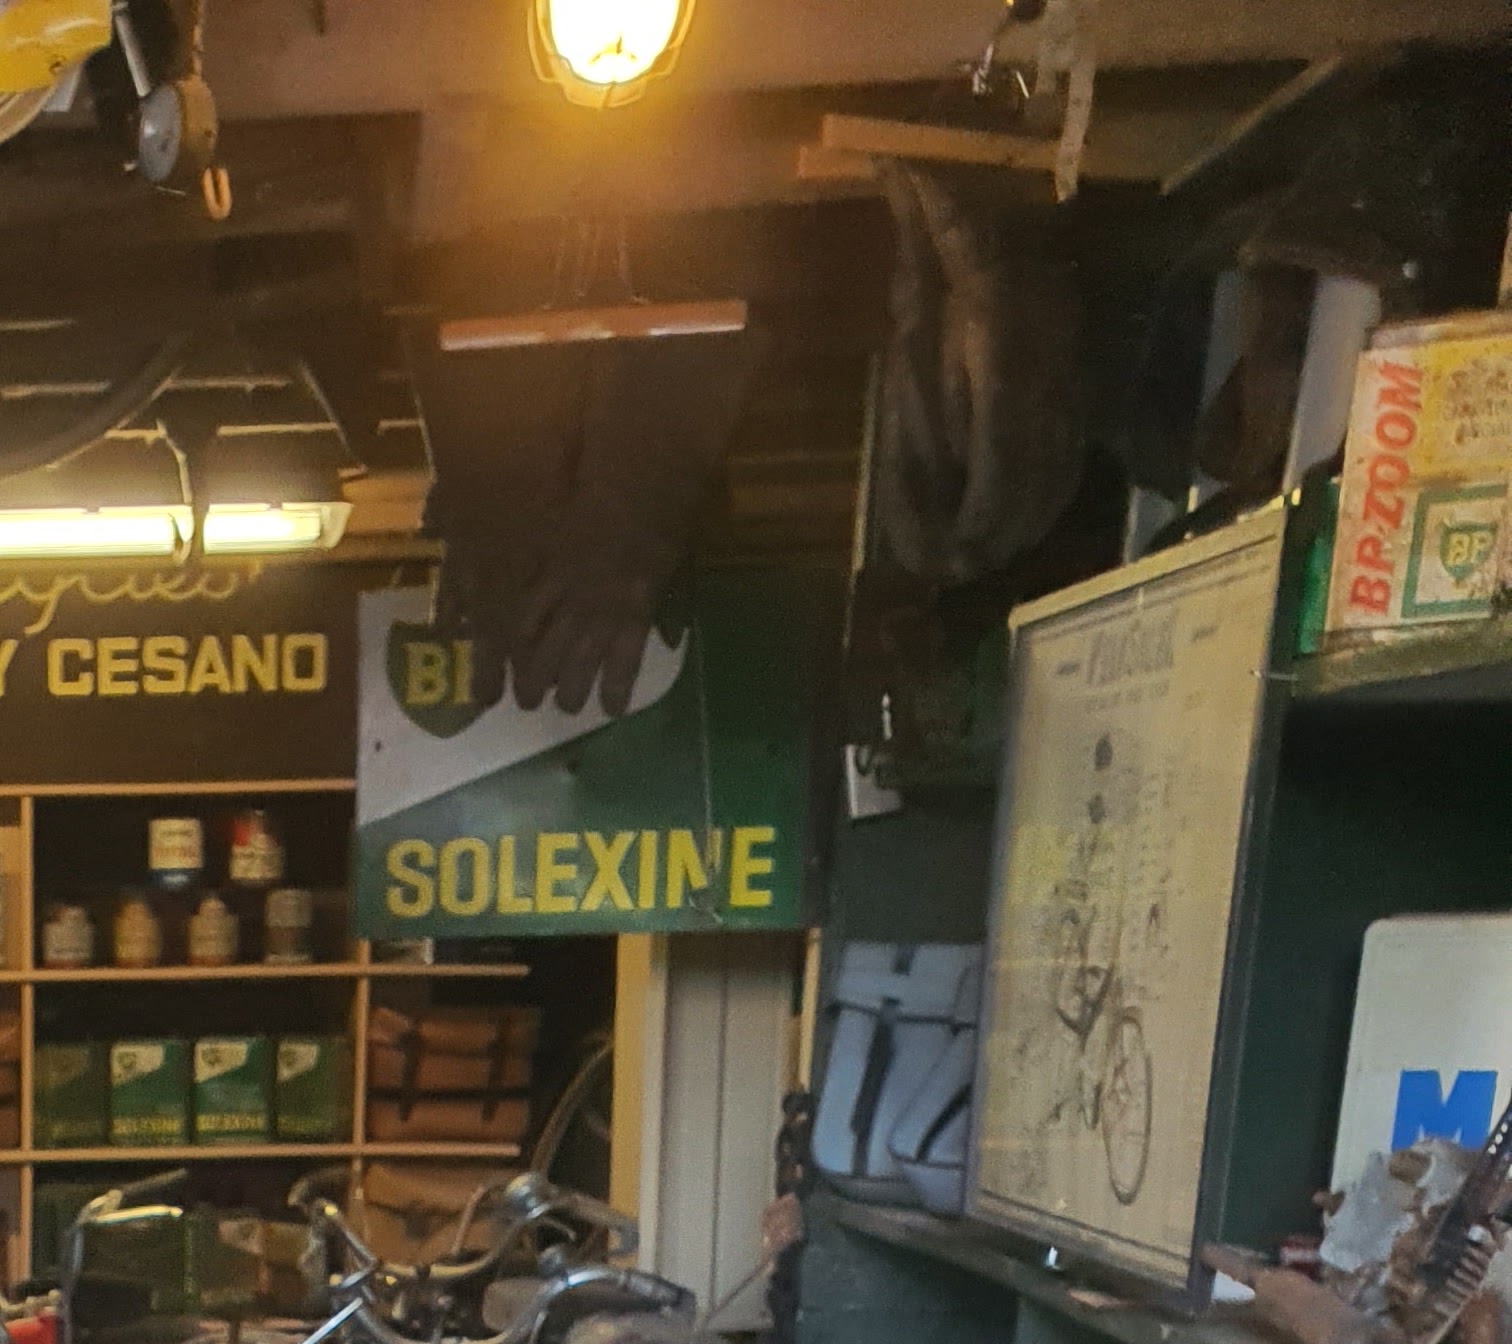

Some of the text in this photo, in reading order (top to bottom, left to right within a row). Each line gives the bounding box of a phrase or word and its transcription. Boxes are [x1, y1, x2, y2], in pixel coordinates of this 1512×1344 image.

[1446, 530, 1491, 567] BP
[47, 632, 330, 697] CESANO
[387, 825, 776, 919] SOLEXINE
